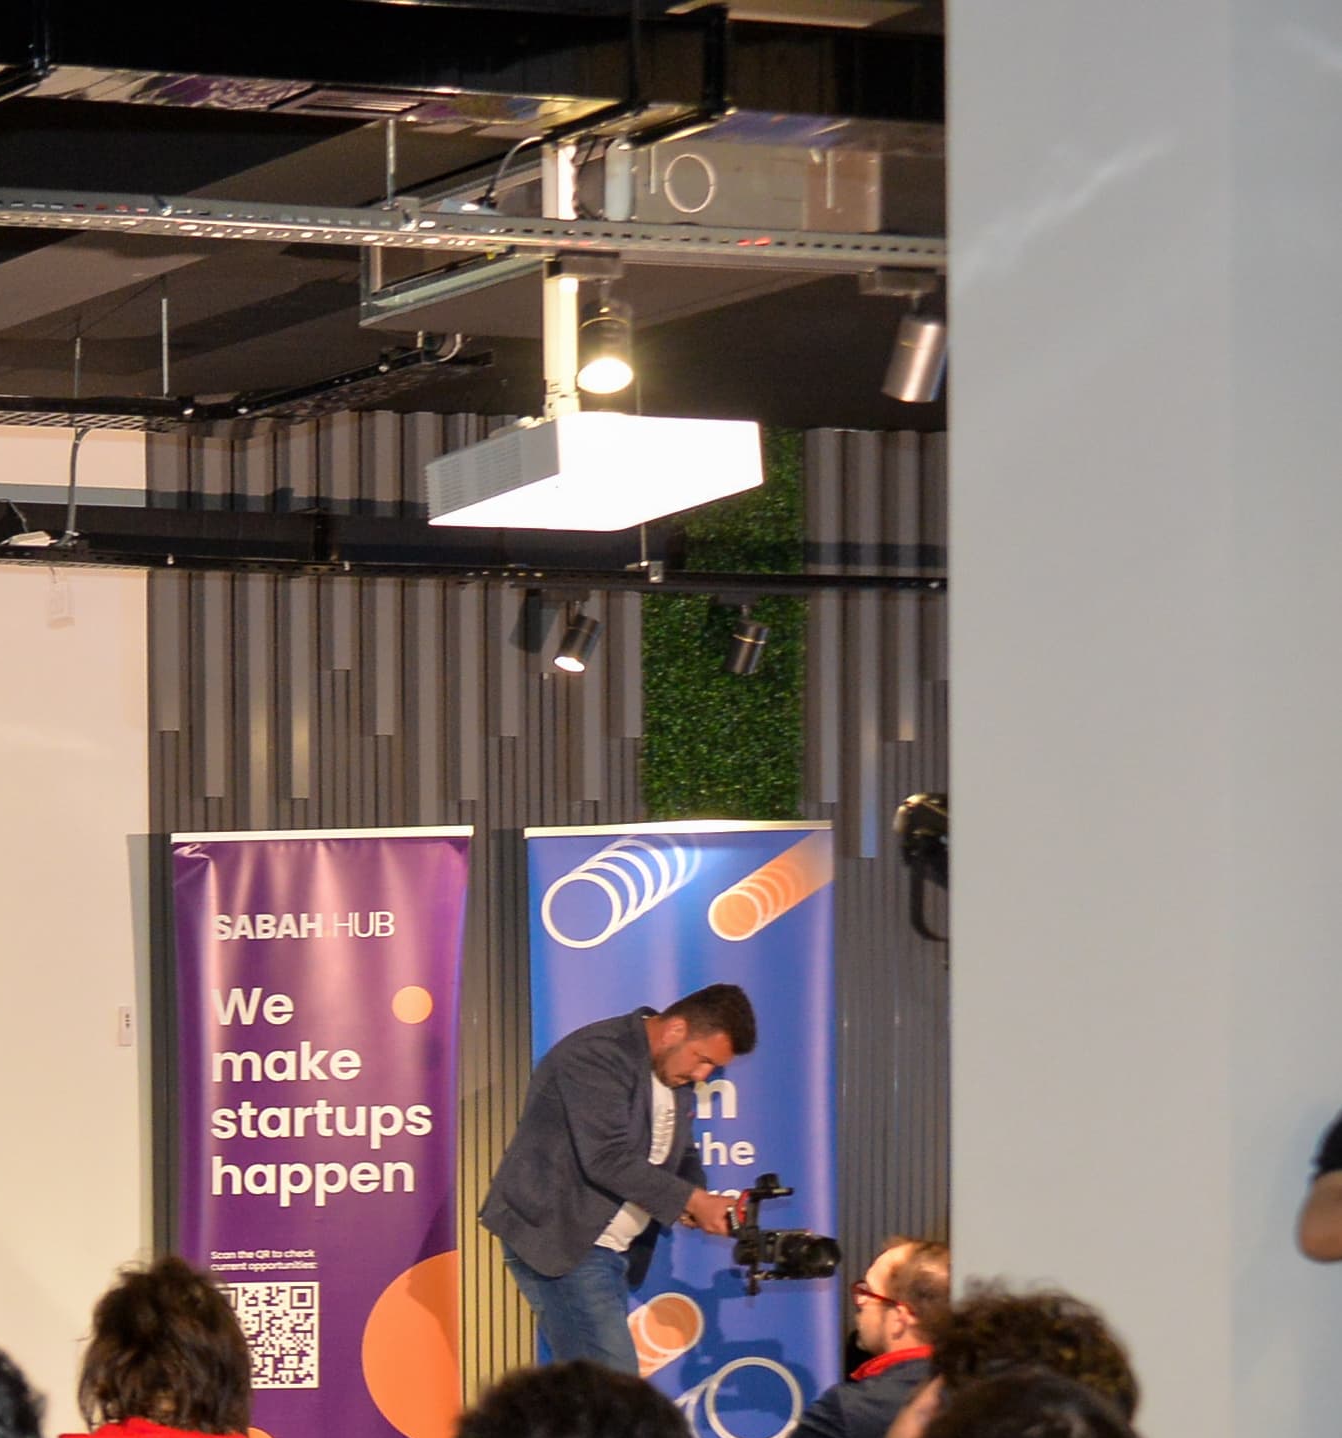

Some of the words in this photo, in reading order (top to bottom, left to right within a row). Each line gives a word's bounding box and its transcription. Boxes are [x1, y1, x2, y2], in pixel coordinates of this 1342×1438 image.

[211, 912, 323, 941] SABAH
[333, 911, 395, 938] HUB
[211, 987, 294, 1026] We
[211, 1040, 362, 1082] make
[210, 1099, 433, 1150] startups
[694, 1131, 755, 1166] he
[211, 1155, 415, 1207] happen
[210, 1250, 236, 1260] Scan
[237, 1250, 254, 1259] the
[255, 1249, 271, 1259] QR
[272, 1250, 283, 1259] to
[284, 1249, 316, 1258] check
[210, 1262, 247, 1271] current
